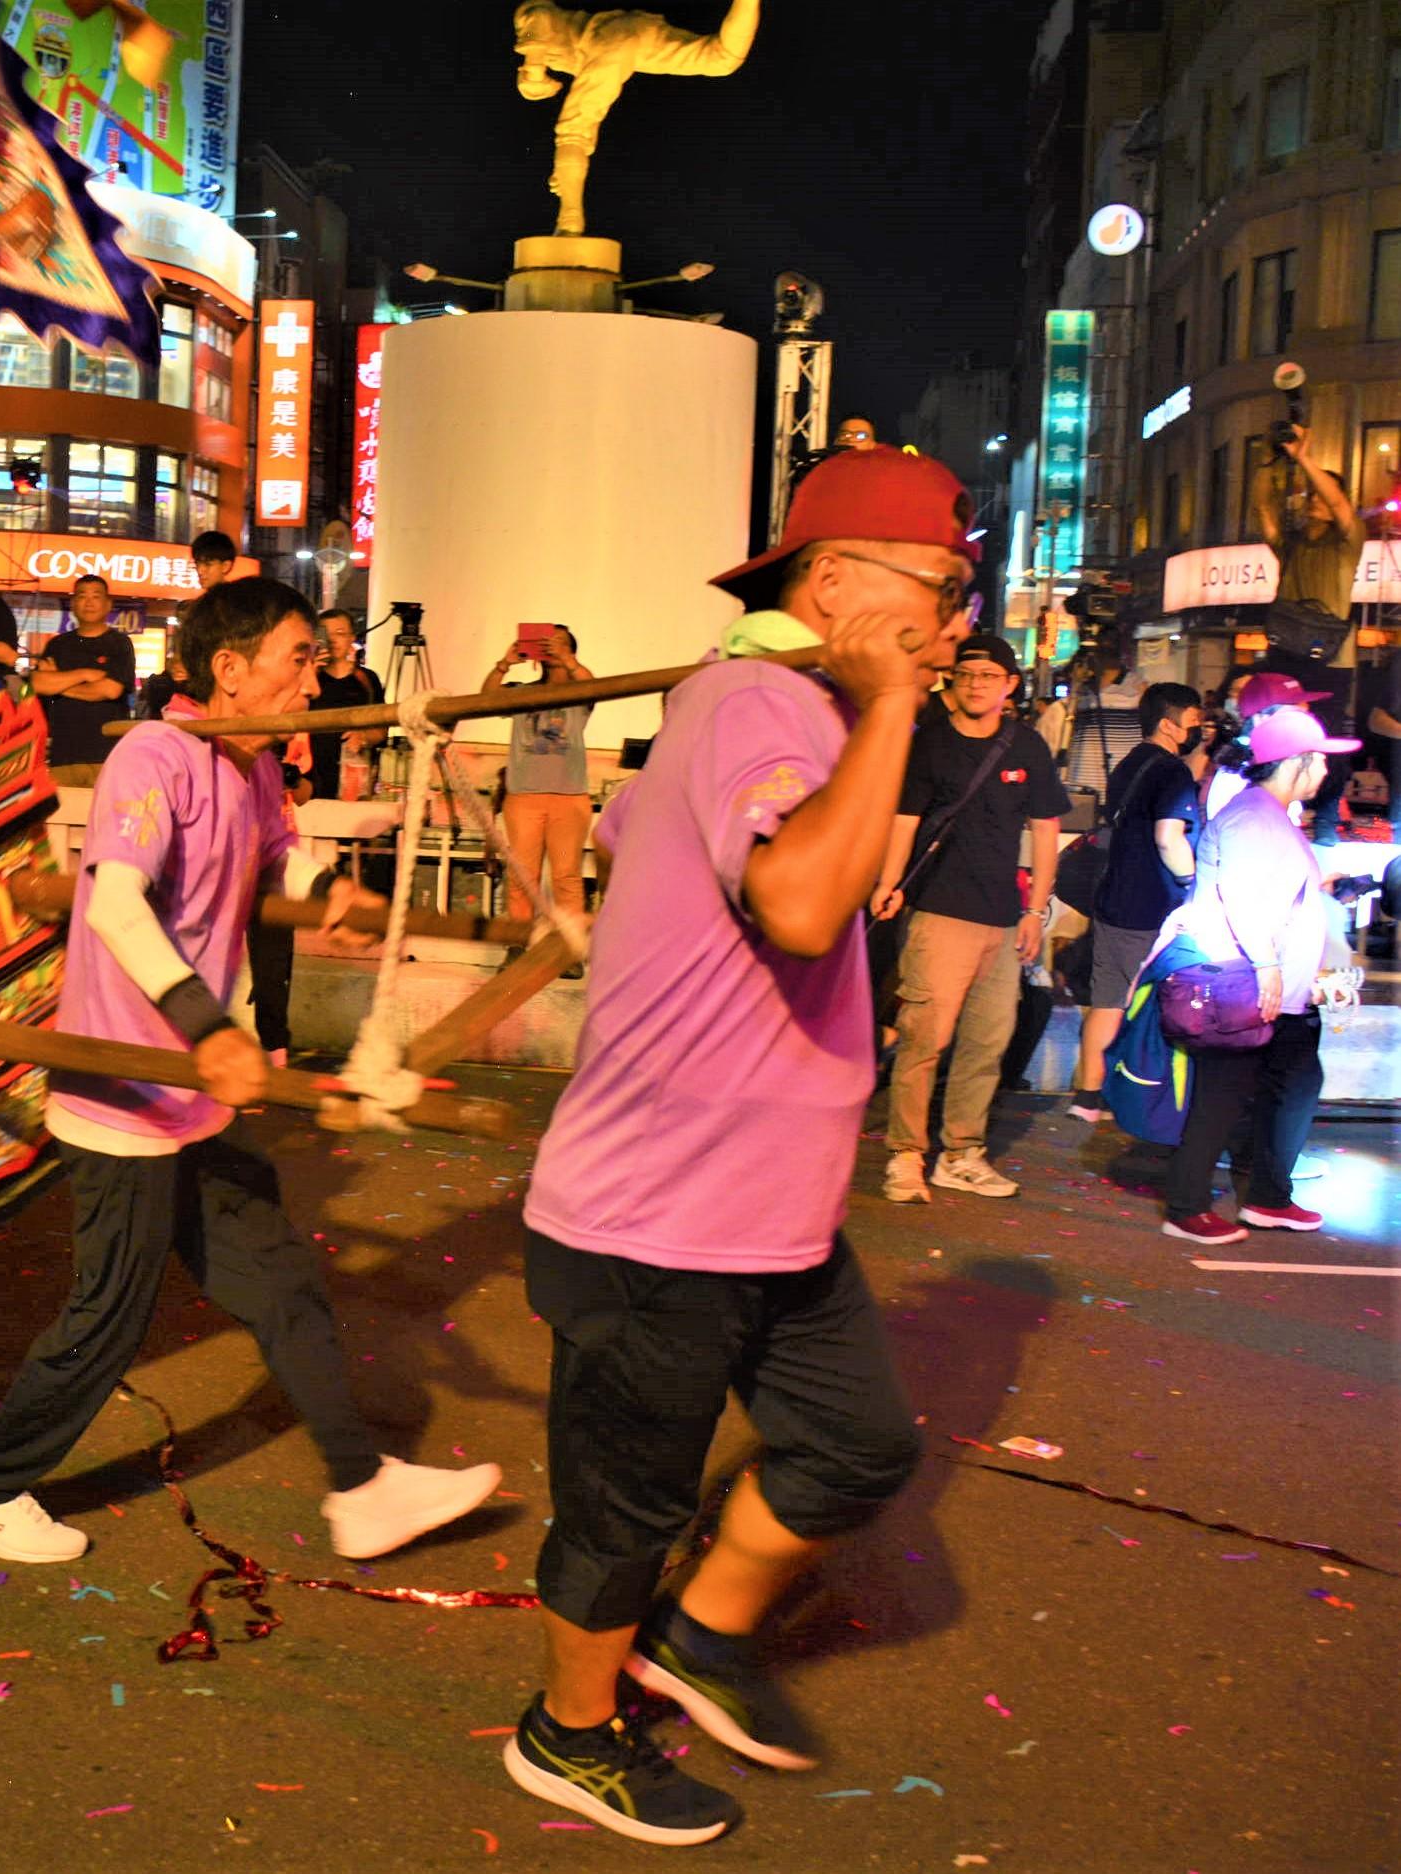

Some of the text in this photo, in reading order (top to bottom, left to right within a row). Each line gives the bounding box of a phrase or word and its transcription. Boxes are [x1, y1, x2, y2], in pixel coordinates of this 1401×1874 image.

[269, 368, 300, 459] 康是美
[28, 549, 150, 583] COSMED
[1201, 563, 1268, 587] LOUISA
